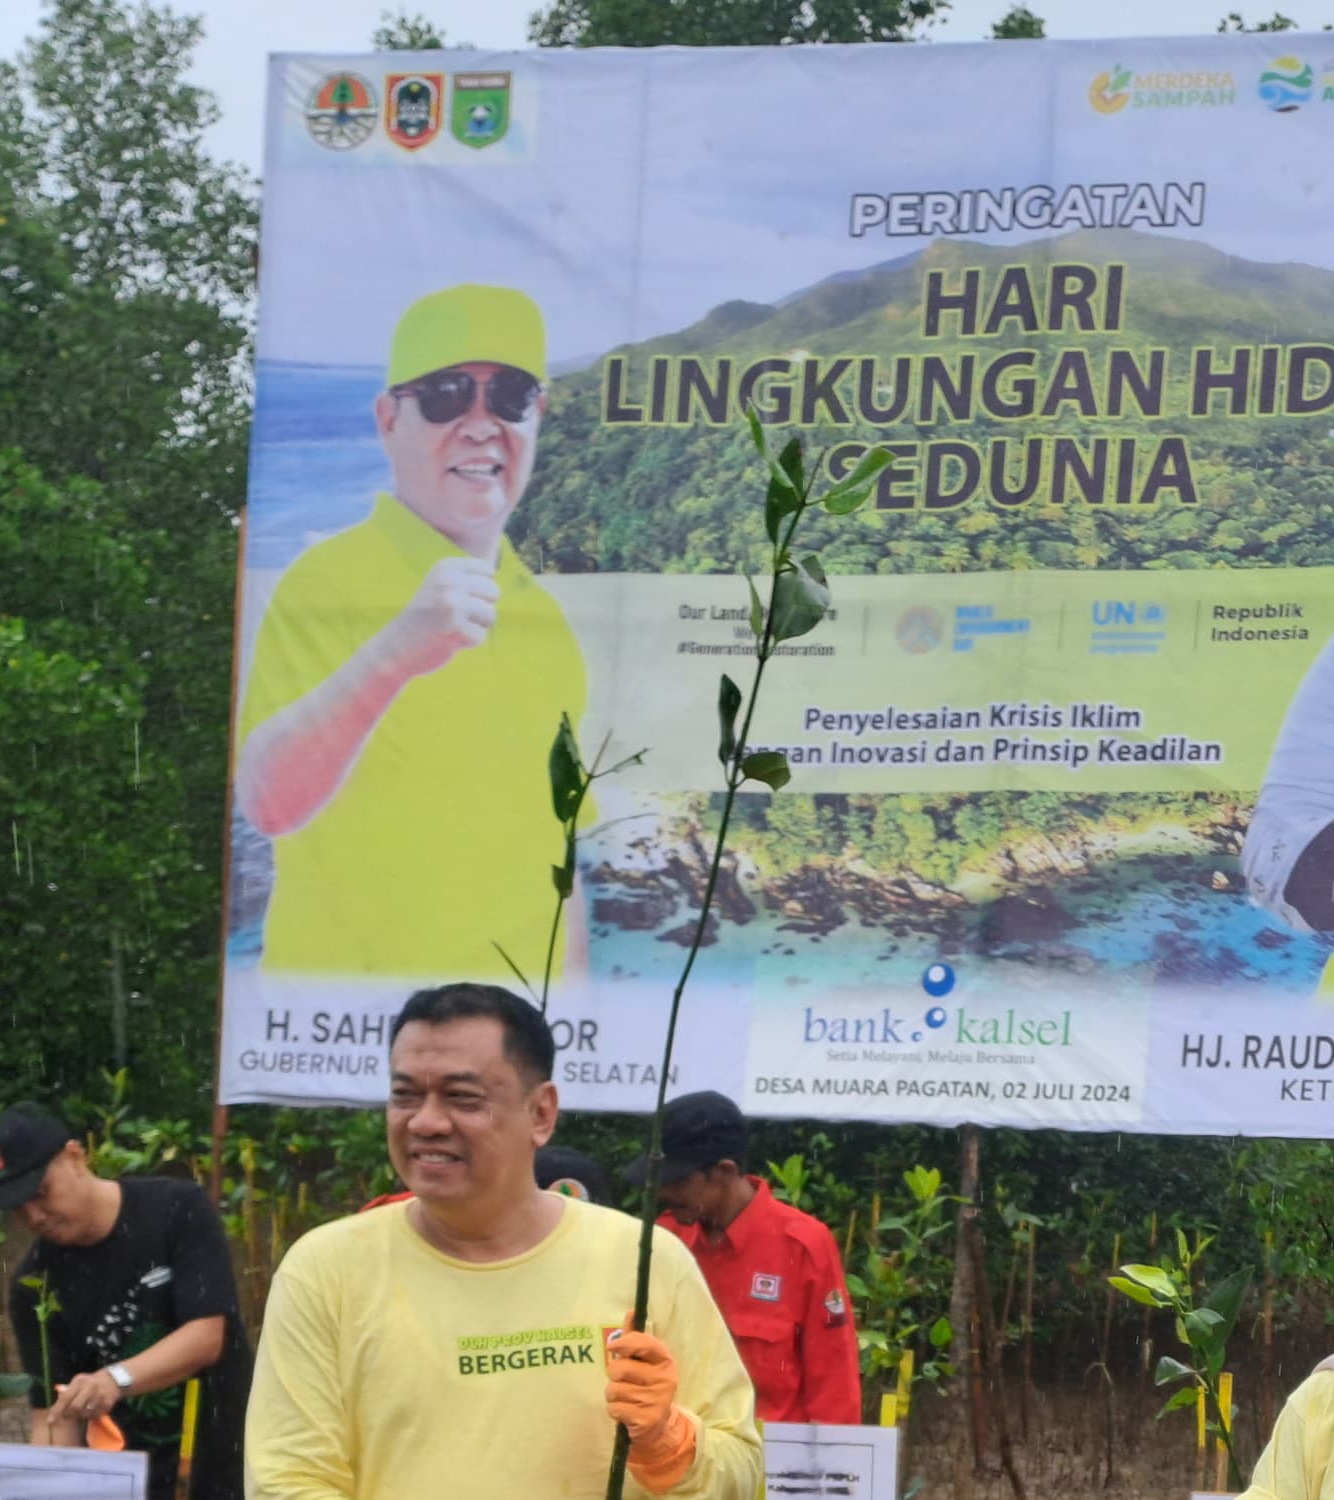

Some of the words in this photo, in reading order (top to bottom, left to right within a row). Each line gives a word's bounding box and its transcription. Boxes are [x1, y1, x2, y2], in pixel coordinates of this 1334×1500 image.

[1133, 72, 1234, 90] MERDEKA
[1133, 90, 1237, 109] SAMPAH
[850, 182, 1206, 237] PERINGATAN
[924, 263, 1125, 338] HARI
[604, 348, 1167, 426] LINGKUNGAN
[1091, 601, 1136, 626] UN
[1213, 604, 1303, 622] Republik
[1211, 625, 1310, 642] Indonesia
[804, 707, 981, 736] Penyelesaian
[989, 704, 1064, 728] Krisis
[1071, 704, 1142, 728] Iklim
[832, 740, 927, 764] Inovasi
[935, 739, 985, 763] dan
[993, 738, 1090, 768] Prinsip
[1098, 738, 1222, 763] Keadilan
[266, 1010, 299, 1043] H.
[803, 1007, 904, 1044] bank
[955, 1007, 1073, 1047] kalsel
[239, 1048, 379, 1077] GUBERNUR
[1181, 1034, 1232, 1068] HJ.
[563, 1061, 679, 1086] SELATAN
[755, 1077, 805, 1095] DESA
[812, 1078, 889, 1097] MUARA
[896, 1079, 996, 1100] PAGATAN,
[1002, 1082, 1027, 1100] 02
[1033, 1083, 1074, 1101] JULI
[1081, 1084, 1131, 1102] 2024
[458, 1344, 595, 1375] BERGERAK
